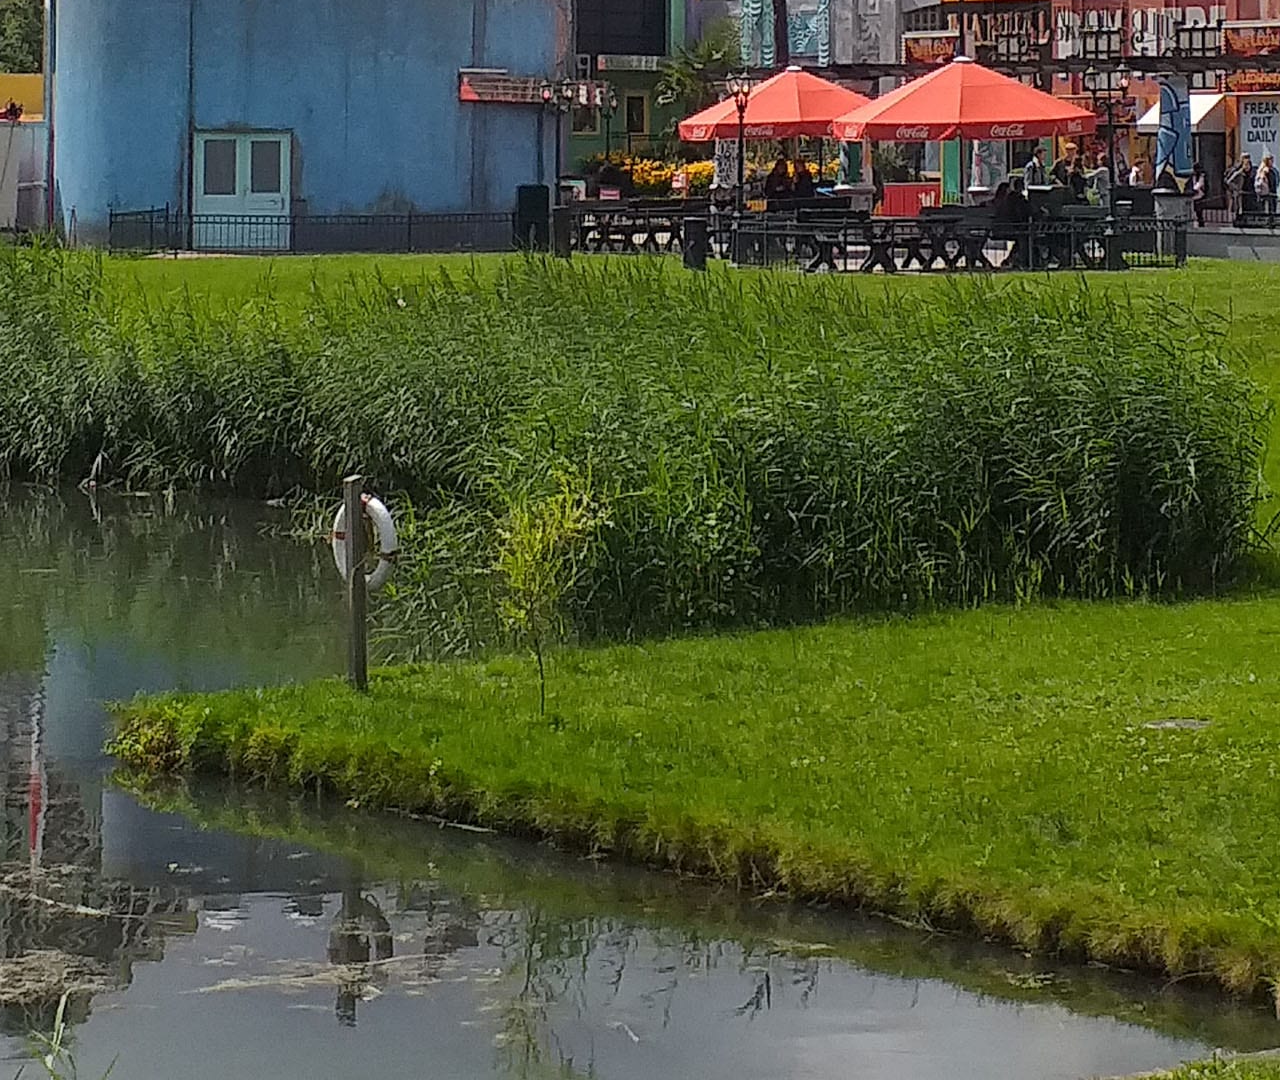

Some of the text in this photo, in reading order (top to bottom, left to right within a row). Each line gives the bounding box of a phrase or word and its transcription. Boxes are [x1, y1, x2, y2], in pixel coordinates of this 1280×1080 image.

[1243, 101, 1280, 115] FREAK
[1251, 116, 1273, 129] OUT
[1247, 129, 1277, 143] DAILY
